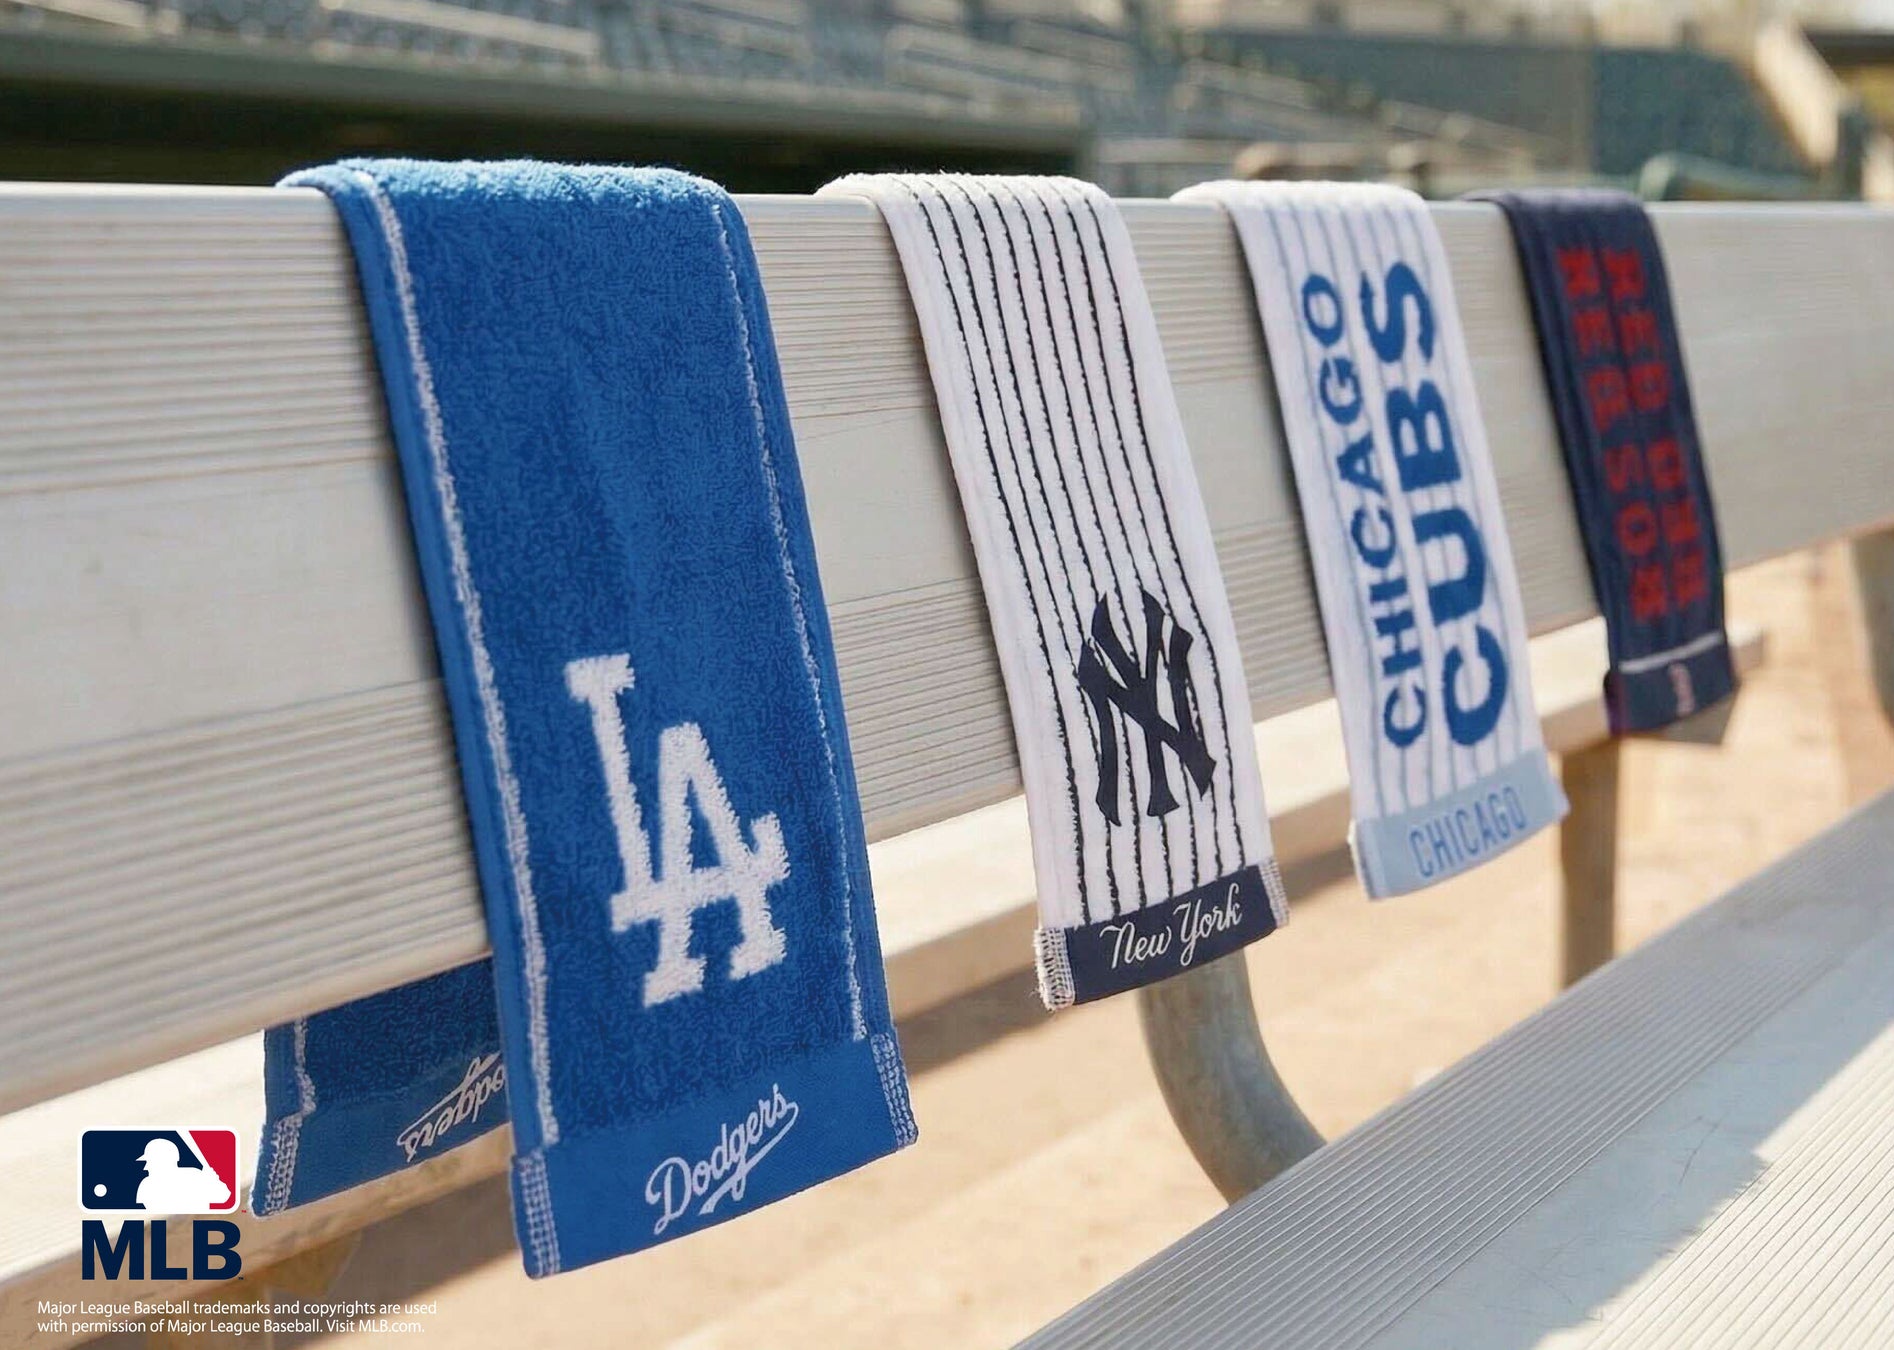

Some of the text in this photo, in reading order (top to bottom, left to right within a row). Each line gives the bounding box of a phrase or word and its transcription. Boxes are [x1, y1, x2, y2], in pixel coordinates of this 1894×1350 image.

[1301, 272, 1427, 749] CHICAGO
[1361, 260, 1509, 747] CUBS
[564, 654, 790, 1008] LA
[1099, 882, 1243, 969] New York
[1409, 786, 1526, 878] CHICAGO
[645, 1083, 800, 1235] Dodgers
